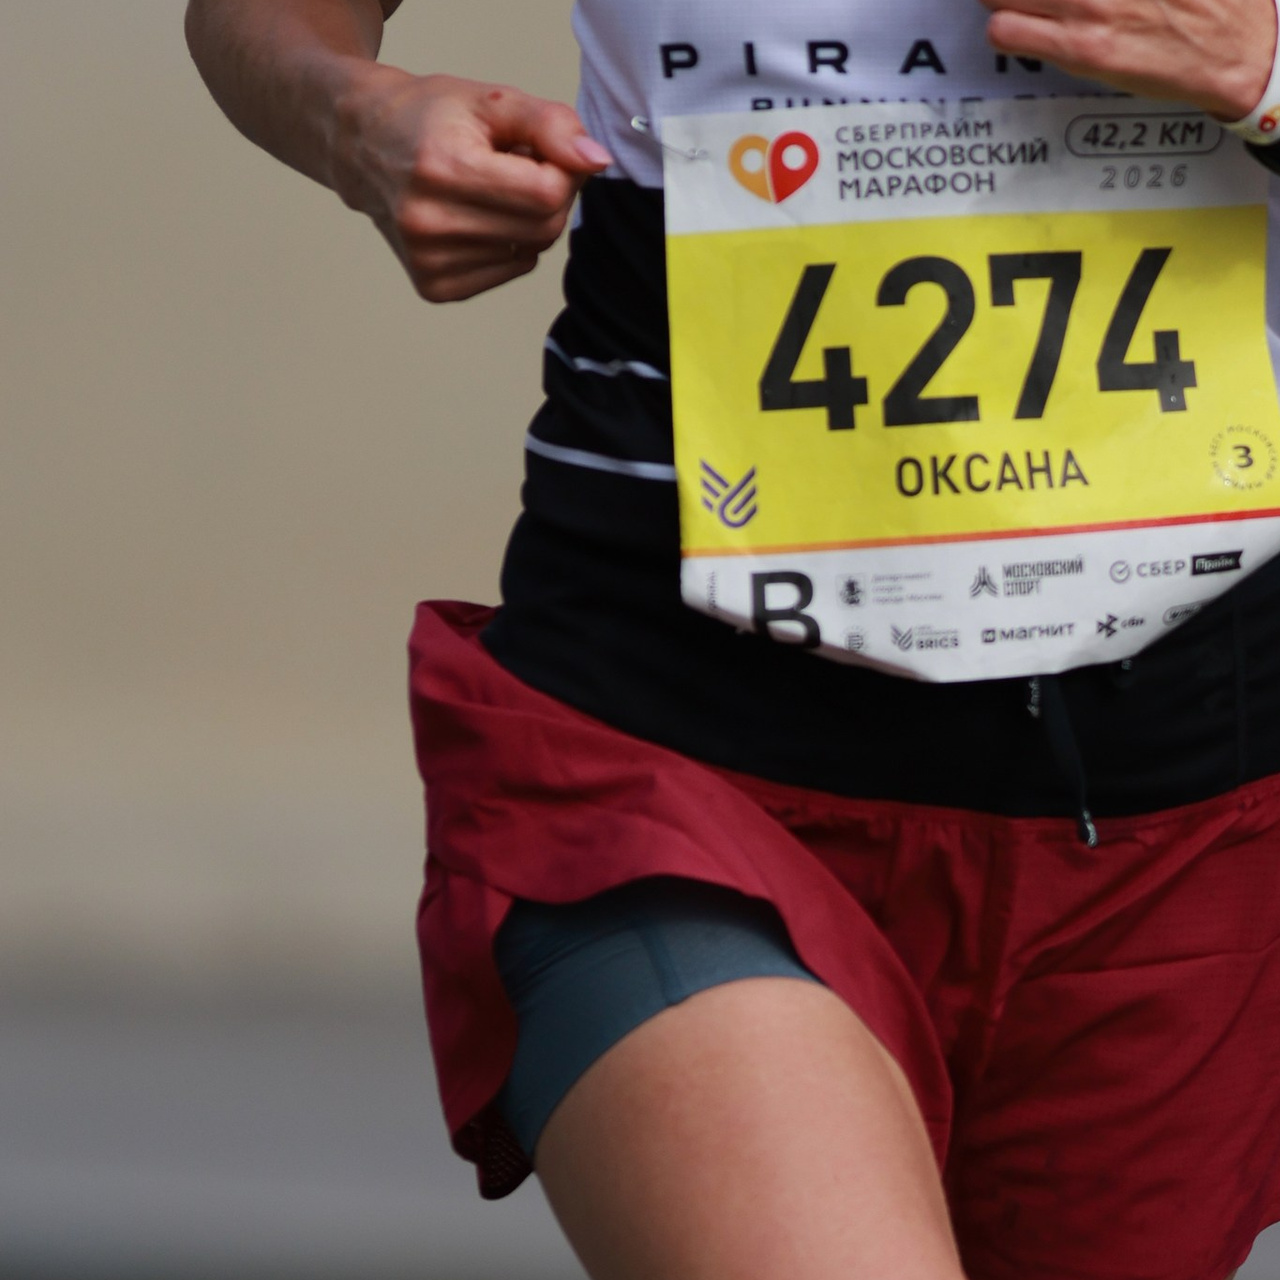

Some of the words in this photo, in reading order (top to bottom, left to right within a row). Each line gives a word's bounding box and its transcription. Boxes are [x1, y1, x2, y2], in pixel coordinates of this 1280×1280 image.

[835, 118, 993, 145] СБЕРПРАЙМ
[1081, 122, 1148, 150] 42,2
[837, 137, 1049, 173] МОСКОВСКИЙ
[839, 171, 996, 200] МАРАФОН
[1100, 164, 1188, 190] 2026
[758, 247, 1198, 431] 4274
[1232, 444, 1255, 469] 3
[896, 449, 1089, 498] ОКСАНА
[1136, 560, 1187, 578] СБЕР
[999, 623, 1076, 642] магнит
